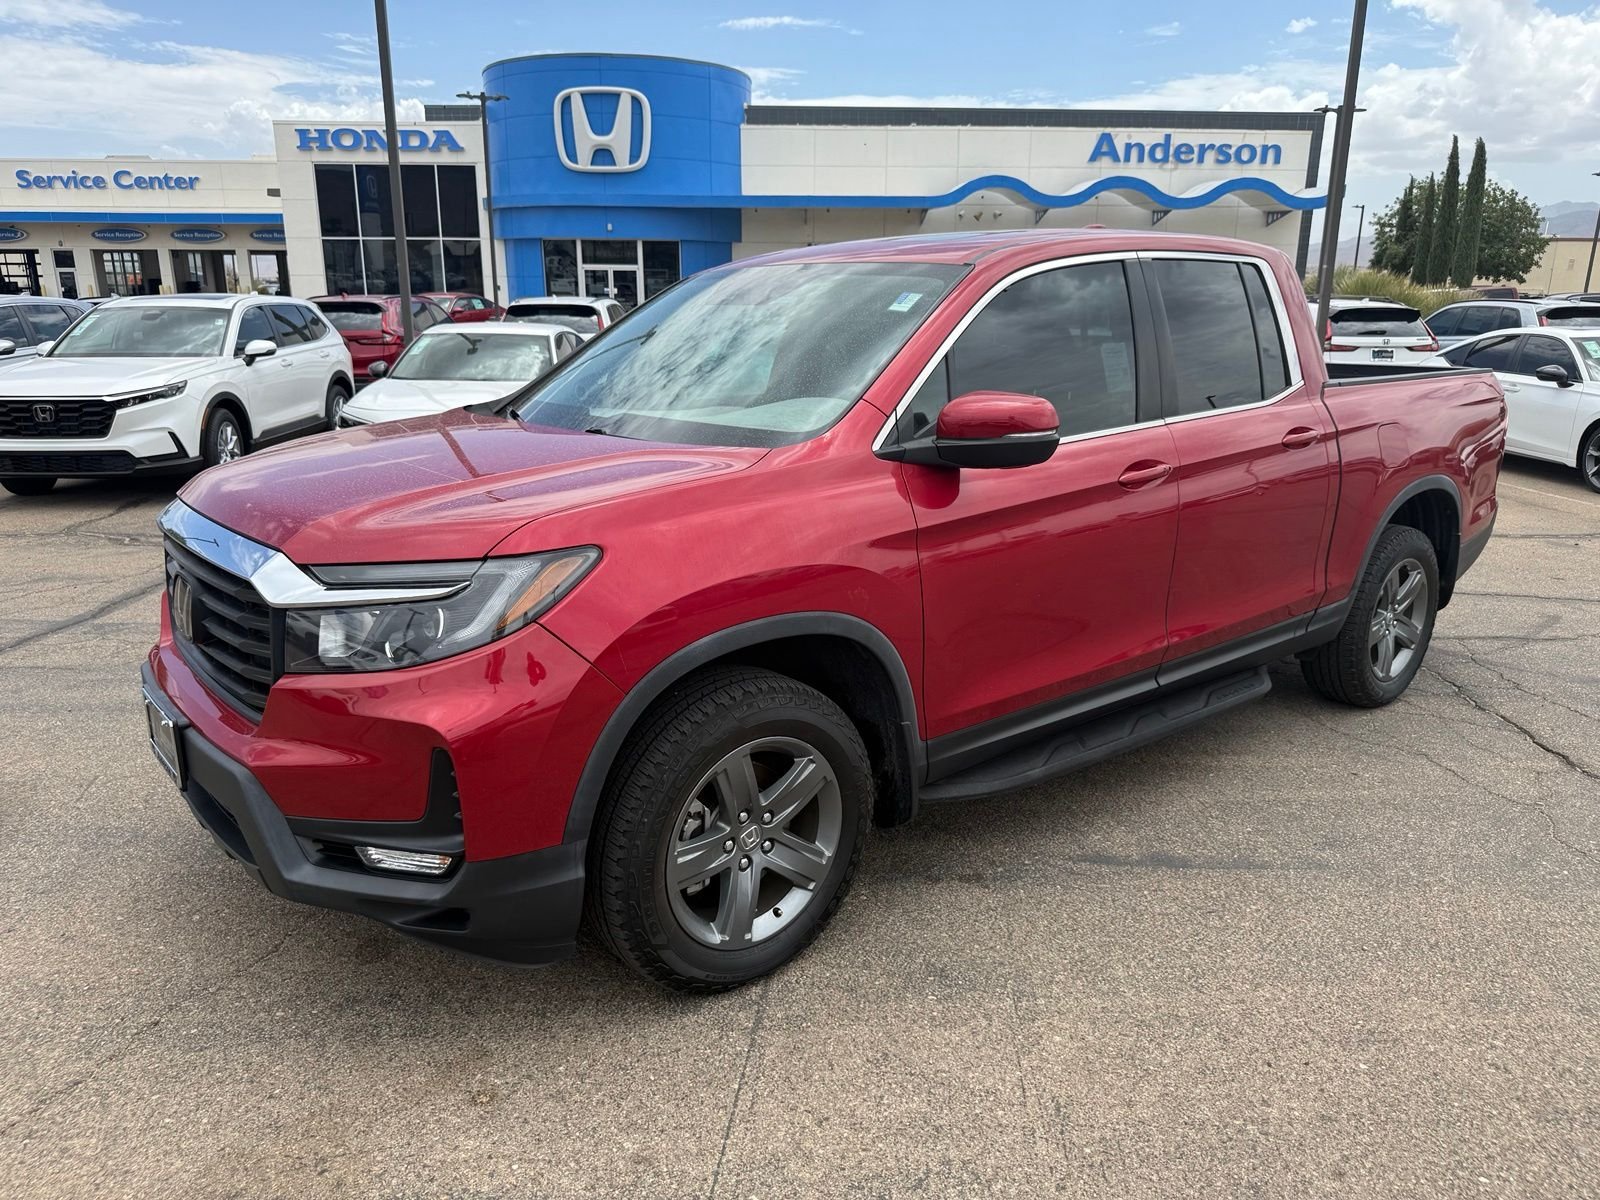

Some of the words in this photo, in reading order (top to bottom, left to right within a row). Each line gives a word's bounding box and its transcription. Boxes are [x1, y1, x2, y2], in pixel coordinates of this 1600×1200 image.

[295, 128, 465, 152] HONDA
[1088, 132, 1282, 165] Anderson
[15, 169, 107, 189] Service
[113, 170, 200, 190] Center
[115, 231, 143, 239] Reception
